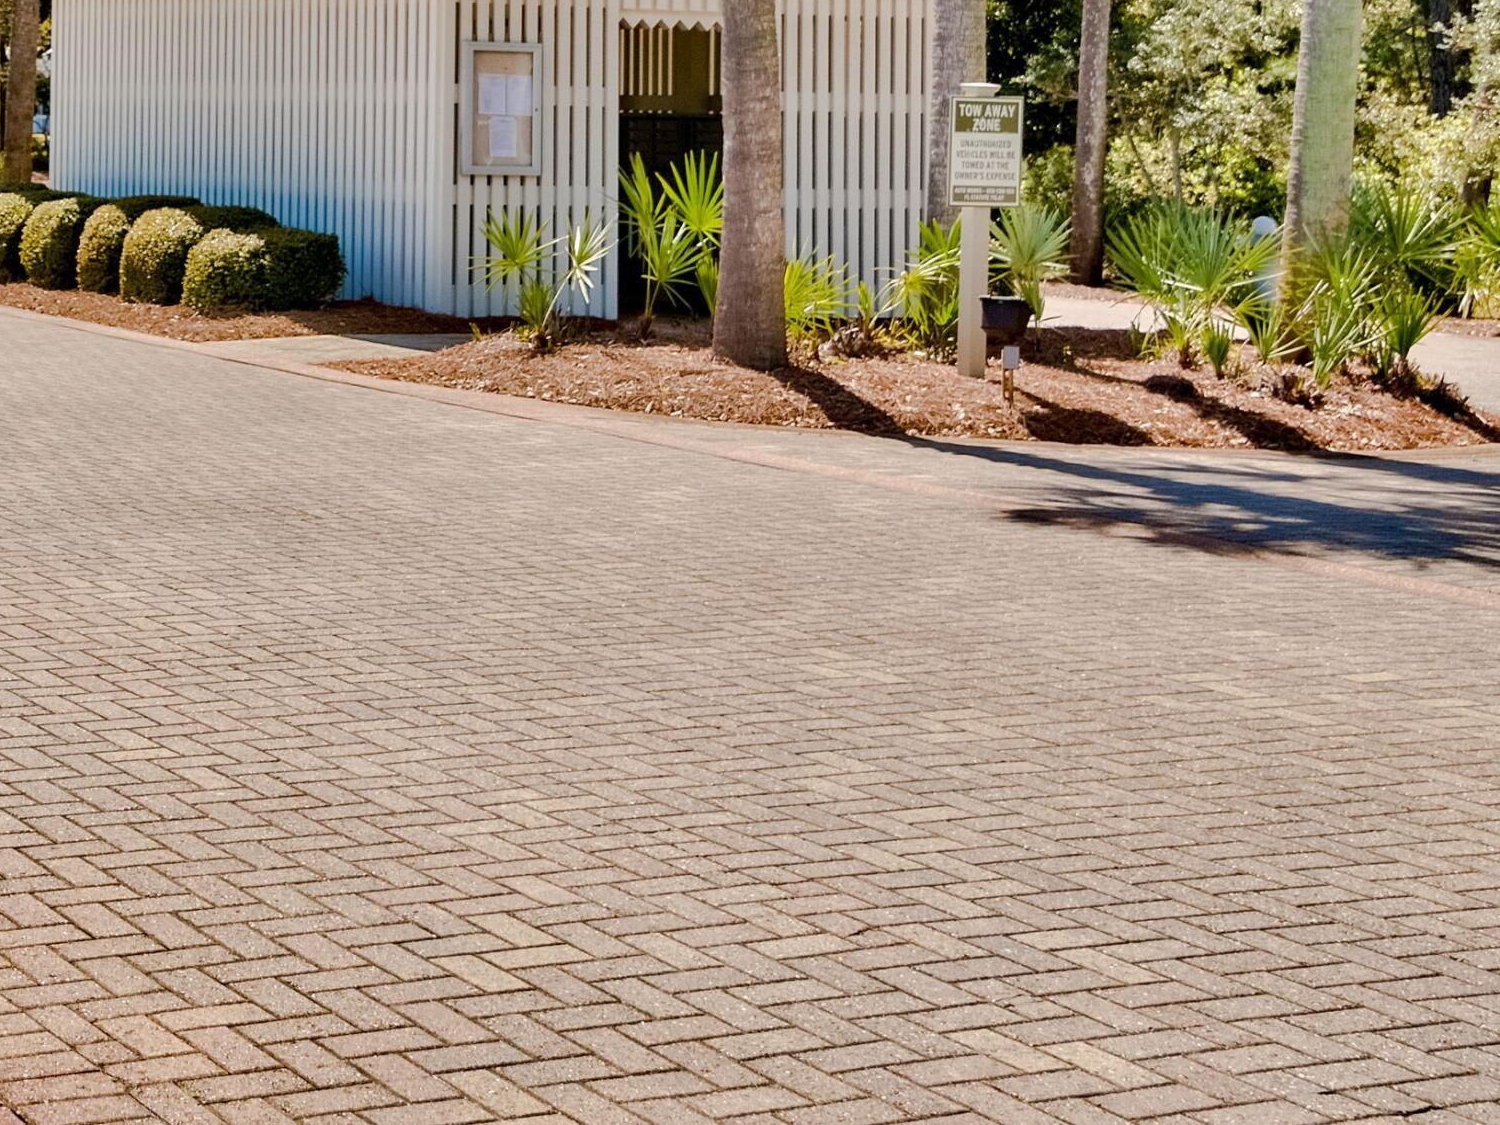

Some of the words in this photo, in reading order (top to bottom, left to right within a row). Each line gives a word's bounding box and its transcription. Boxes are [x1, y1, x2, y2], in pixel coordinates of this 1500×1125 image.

[959, 104, 983, 117] TOW
[985, 104, 1016, 118] AWAY
[972, 118, 1001, 132] ZONE
[960, 139, 1012, 148] UNAUTHORIZED
[956, 150, 988, 159] VEHICLES
[989, 151, 1005, 159] WILL
[1006, 151, 1016, 160] BE
[961, 161, 985, 170] TOWED
[986, 161, 995, 170] AT
[997, 161, 1010, 170] THE
[954, 171, 985, 180] OWNER'S
[986, 172, 1016, 181] EXPENSE
